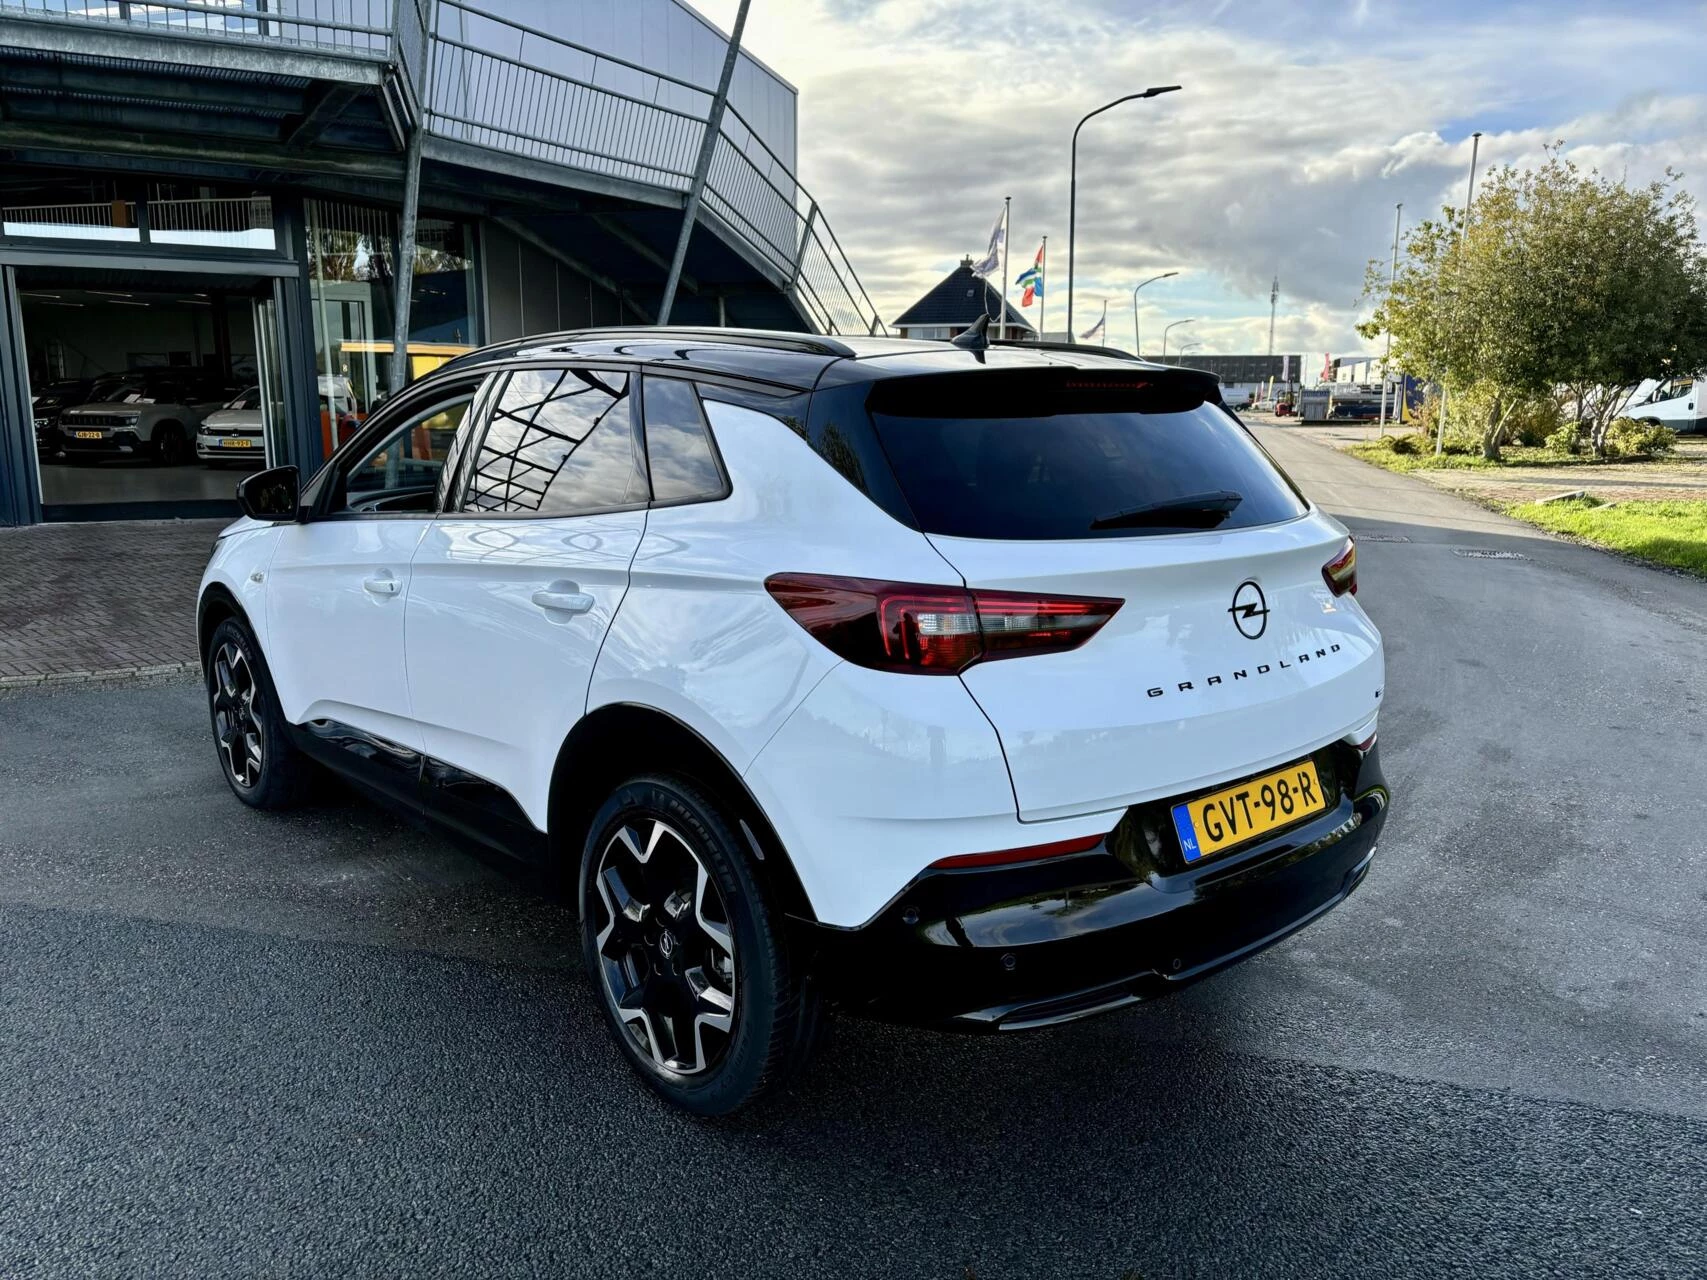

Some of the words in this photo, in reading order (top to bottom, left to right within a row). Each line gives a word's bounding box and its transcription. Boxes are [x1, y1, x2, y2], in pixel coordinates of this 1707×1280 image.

[1147, 644, 1341, 697] GRANDLAND
[1203, 771, 1317, 842] GVT-98-R
[1183, 838, 1197, 851] NL
